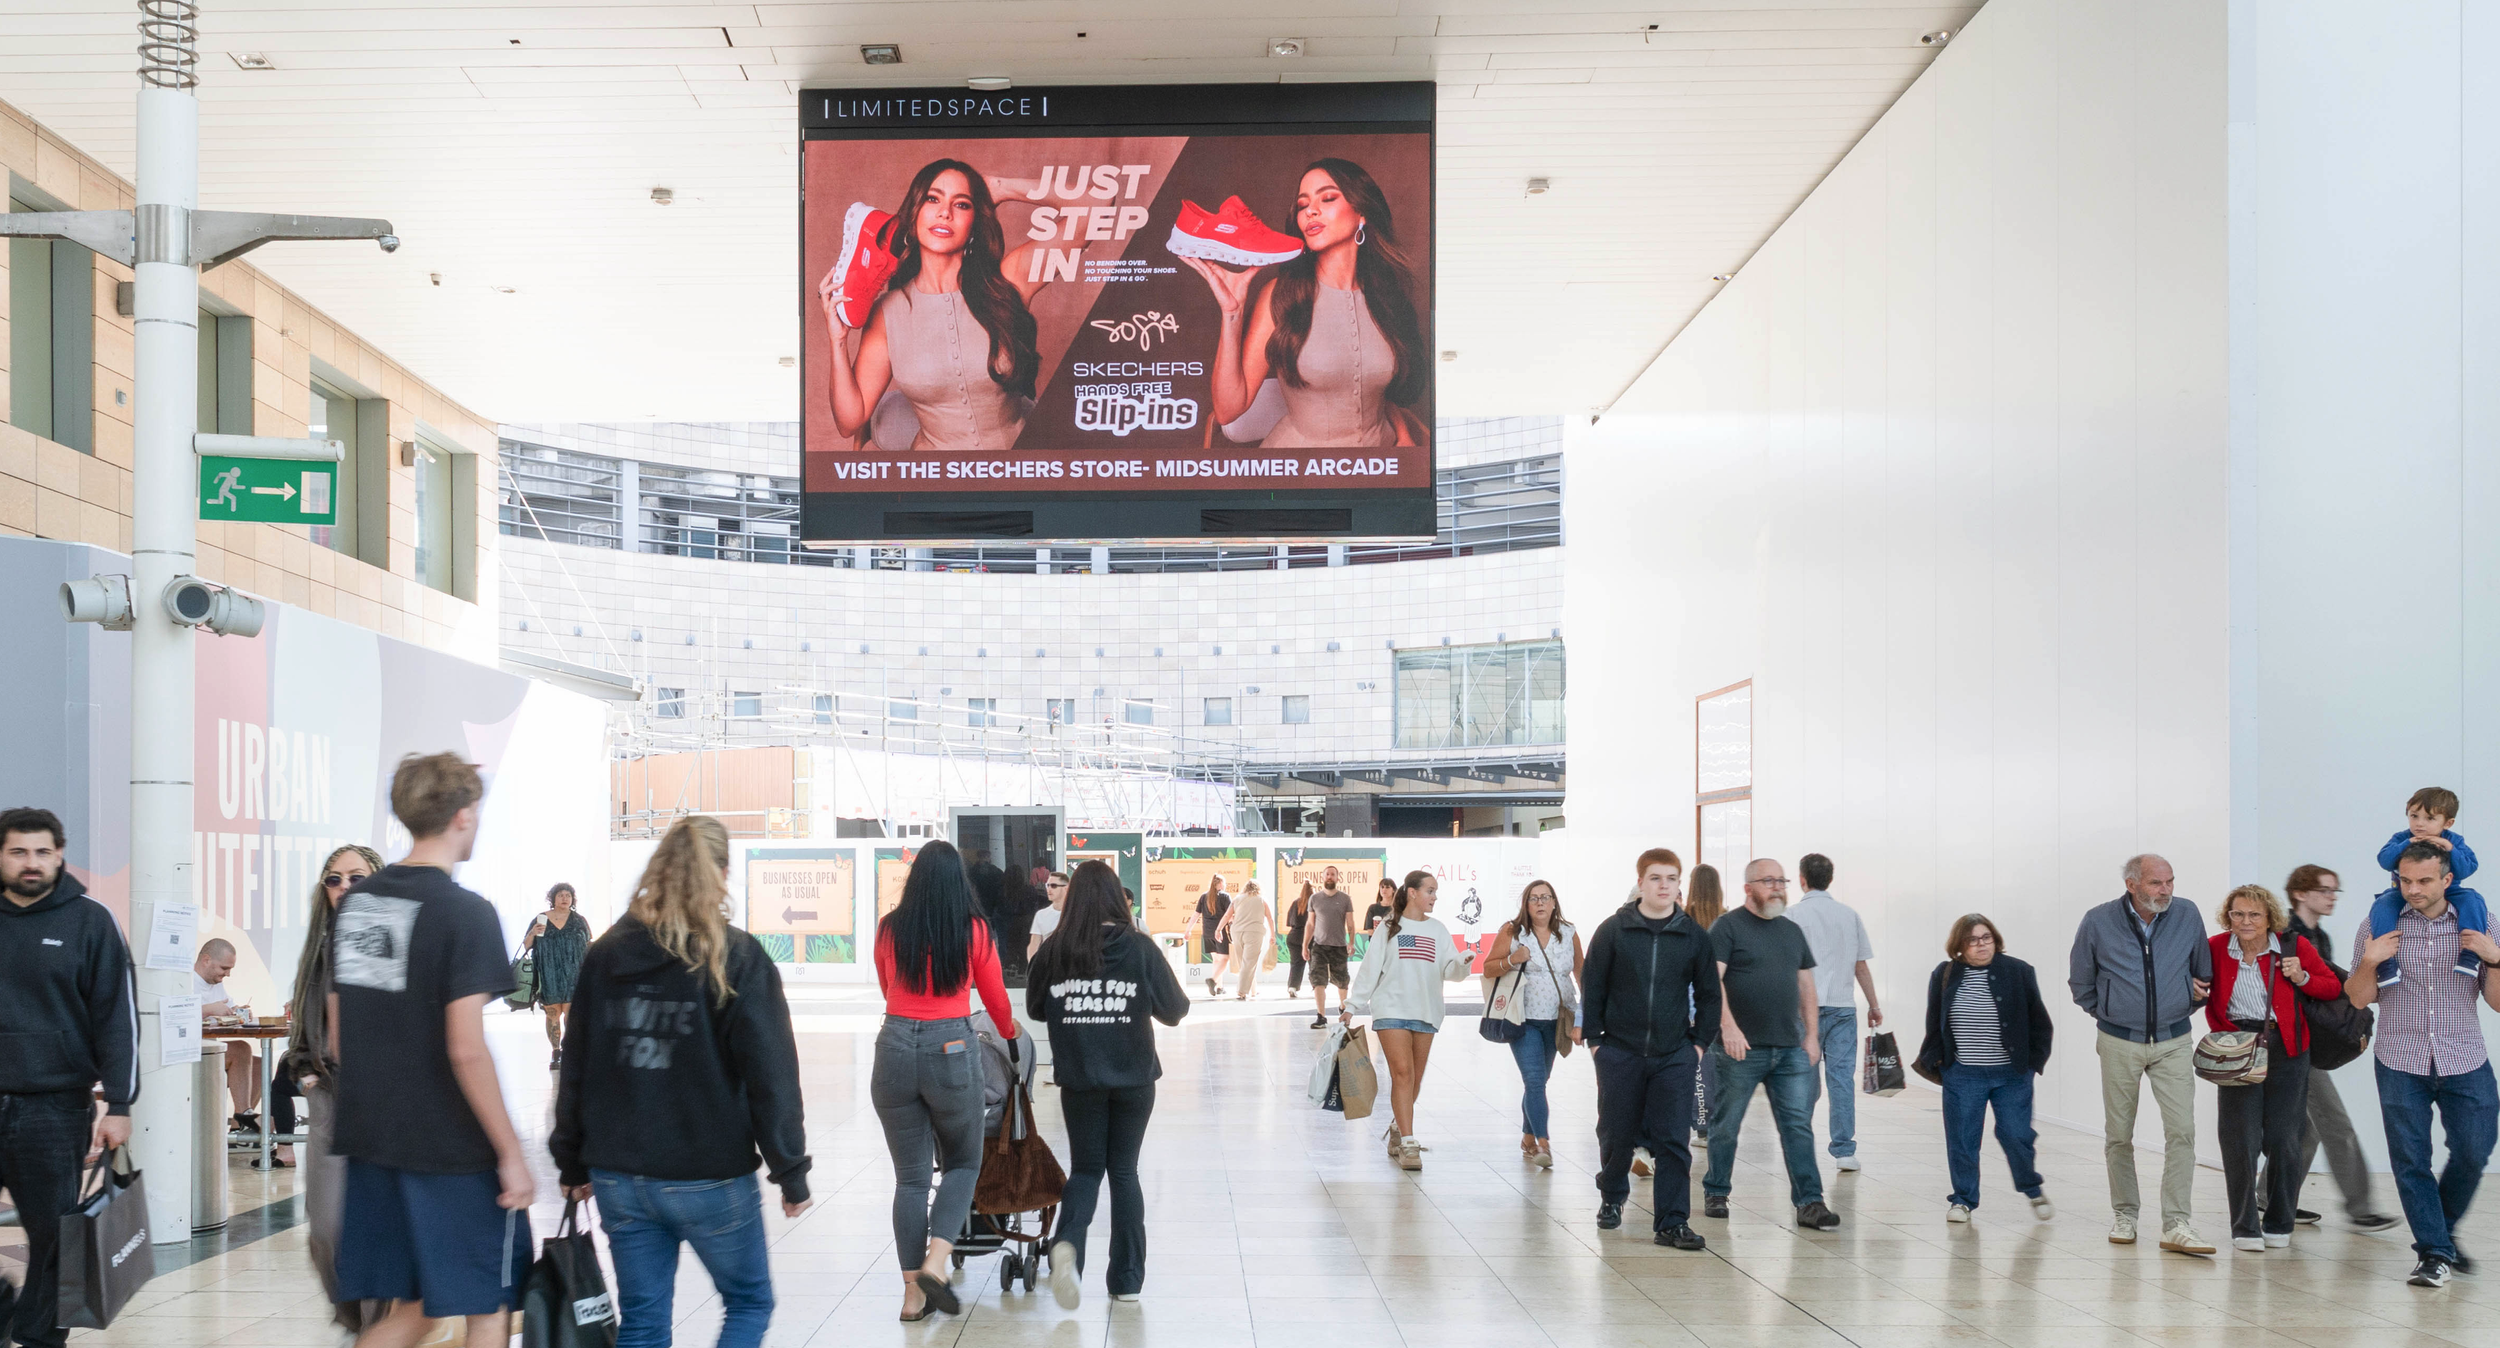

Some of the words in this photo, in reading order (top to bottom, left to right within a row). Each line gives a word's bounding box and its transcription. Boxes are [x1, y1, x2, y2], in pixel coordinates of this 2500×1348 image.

[837, 98, 1031, 118] LIMITEDSPACE
[1026, 164, 1151, 200] JUST
[1026, 206, 1149, 241] STEP
[1027, 248, 1082, 283] IN
[1073, 361, 1203, 377] SKECHERS
[1075, 384, 1128, 398] HANDS
[1132, 382, 1171, 396] FREE
[1076, 396, 1198, 434] Slip-ins
[834, 462, 891, 479] VISIT
[897, 462, 941, 479] THE
[946, 461, 1063, 478] SKECHERS
[1069, 461, 1149, 478] STORE-
[1156, 459, 1299, 477] MIDSUMMER
[1304, 458, 1398, 476] ARCADE
[218, 718, 330, 825] URBAN
[762, 871, 812, 884] BUSINESSES
[815, 871, 837, 884] OPEN
[1346, 871, 1368, 884] OPEN
[781, 886, 792, 899] AS
[794, 886, 820, 899] USUAL
[1050, 979, 1102, 998] WHITE
[1106, 980, 1137, 997] FOX
[1064, 996, 1127, 1012] SEASON
[1062, 1016, 1115, 1024] ESTABLISHED
[1694, 1081, 1709, 1125] Superdry
